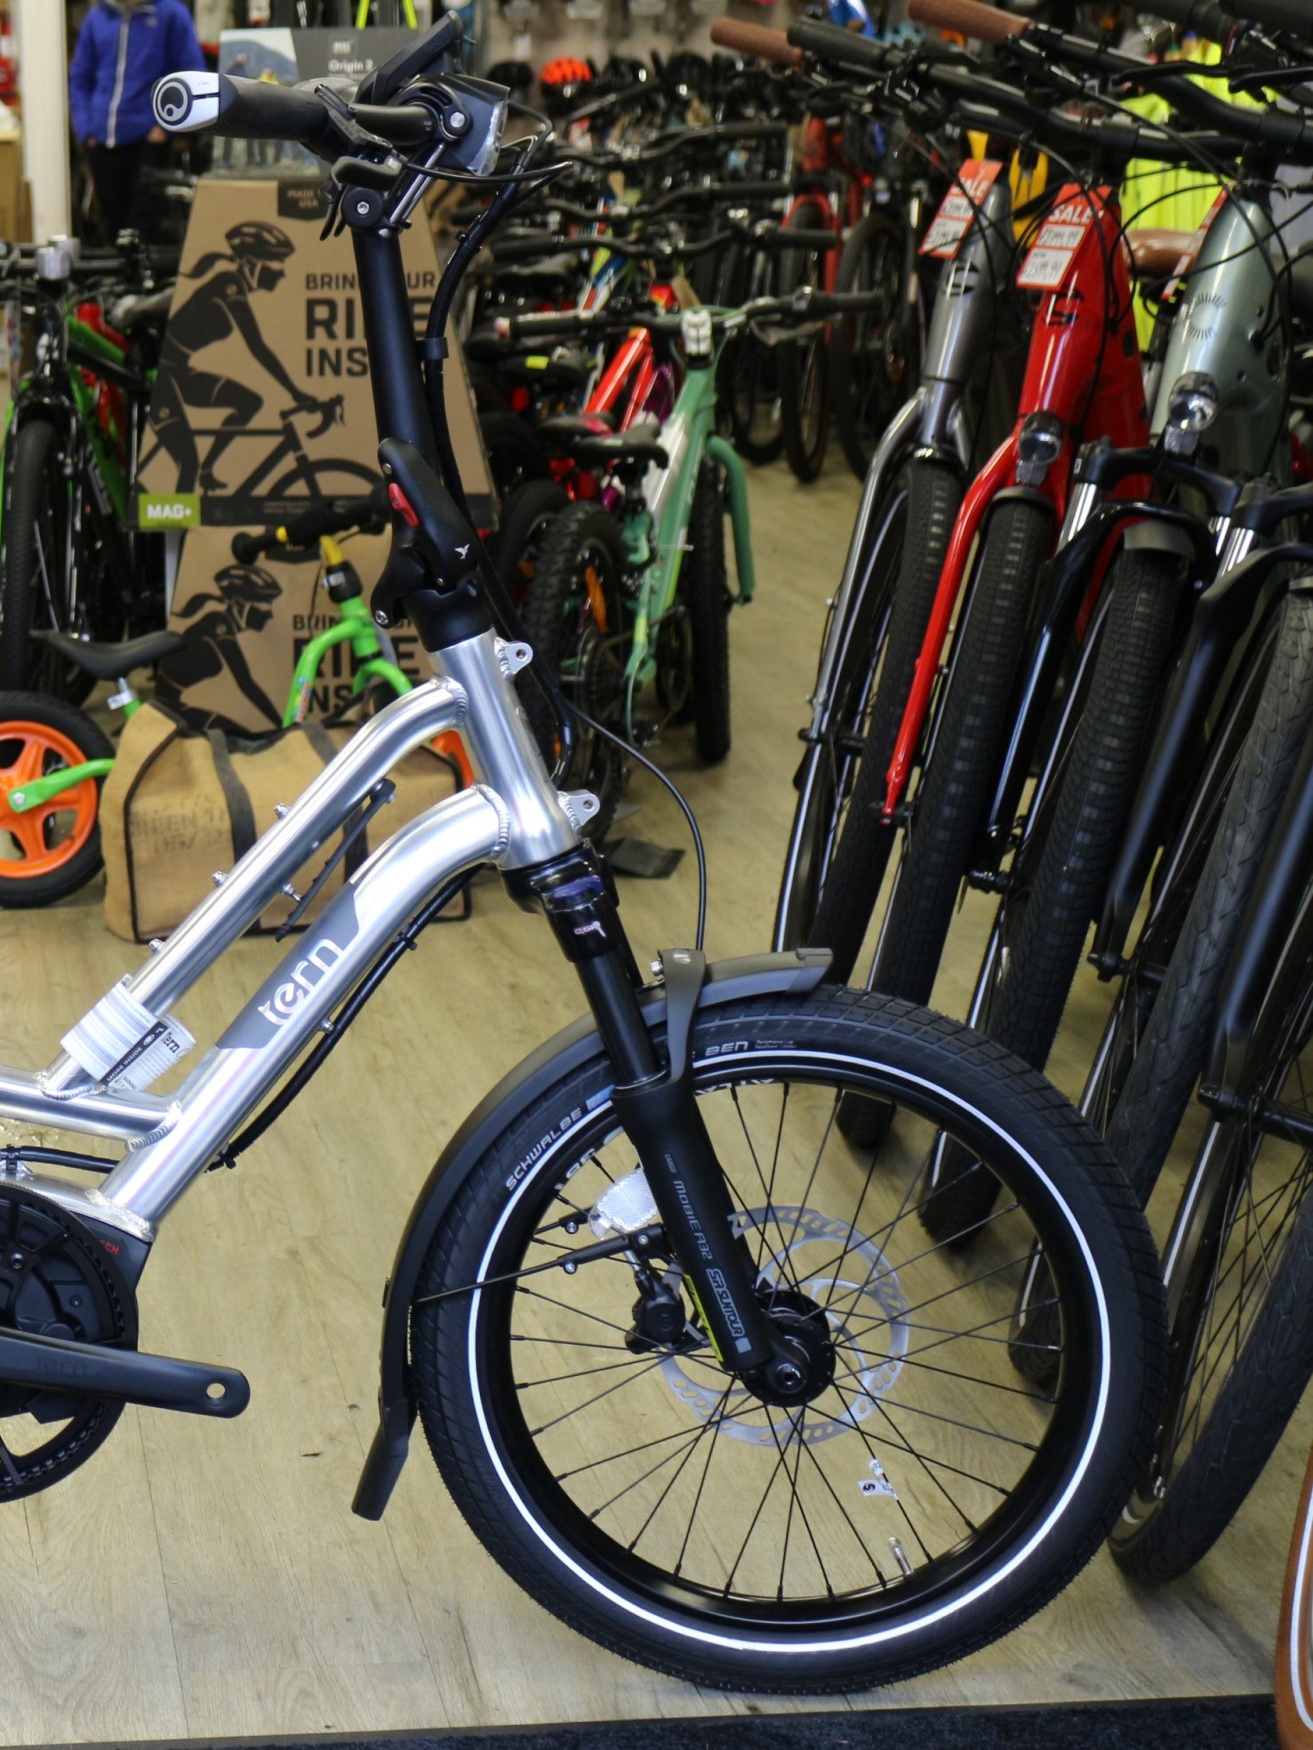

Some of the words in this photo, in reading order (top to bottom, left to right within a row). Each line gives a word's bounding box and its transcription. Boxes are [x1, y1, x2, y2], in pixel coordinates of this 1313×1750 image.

[305, 273, 357, 291] BRIN
[306, 296, 435, 340] RIE
[306, 346, 369, 377] INS
[146, 503, 193, 520] MAG+
[257, 938, 346, 1027] tern
[705, 1041, 749, 1057] BEN
[505, 1107, 583, 1192] SCHWALBE
